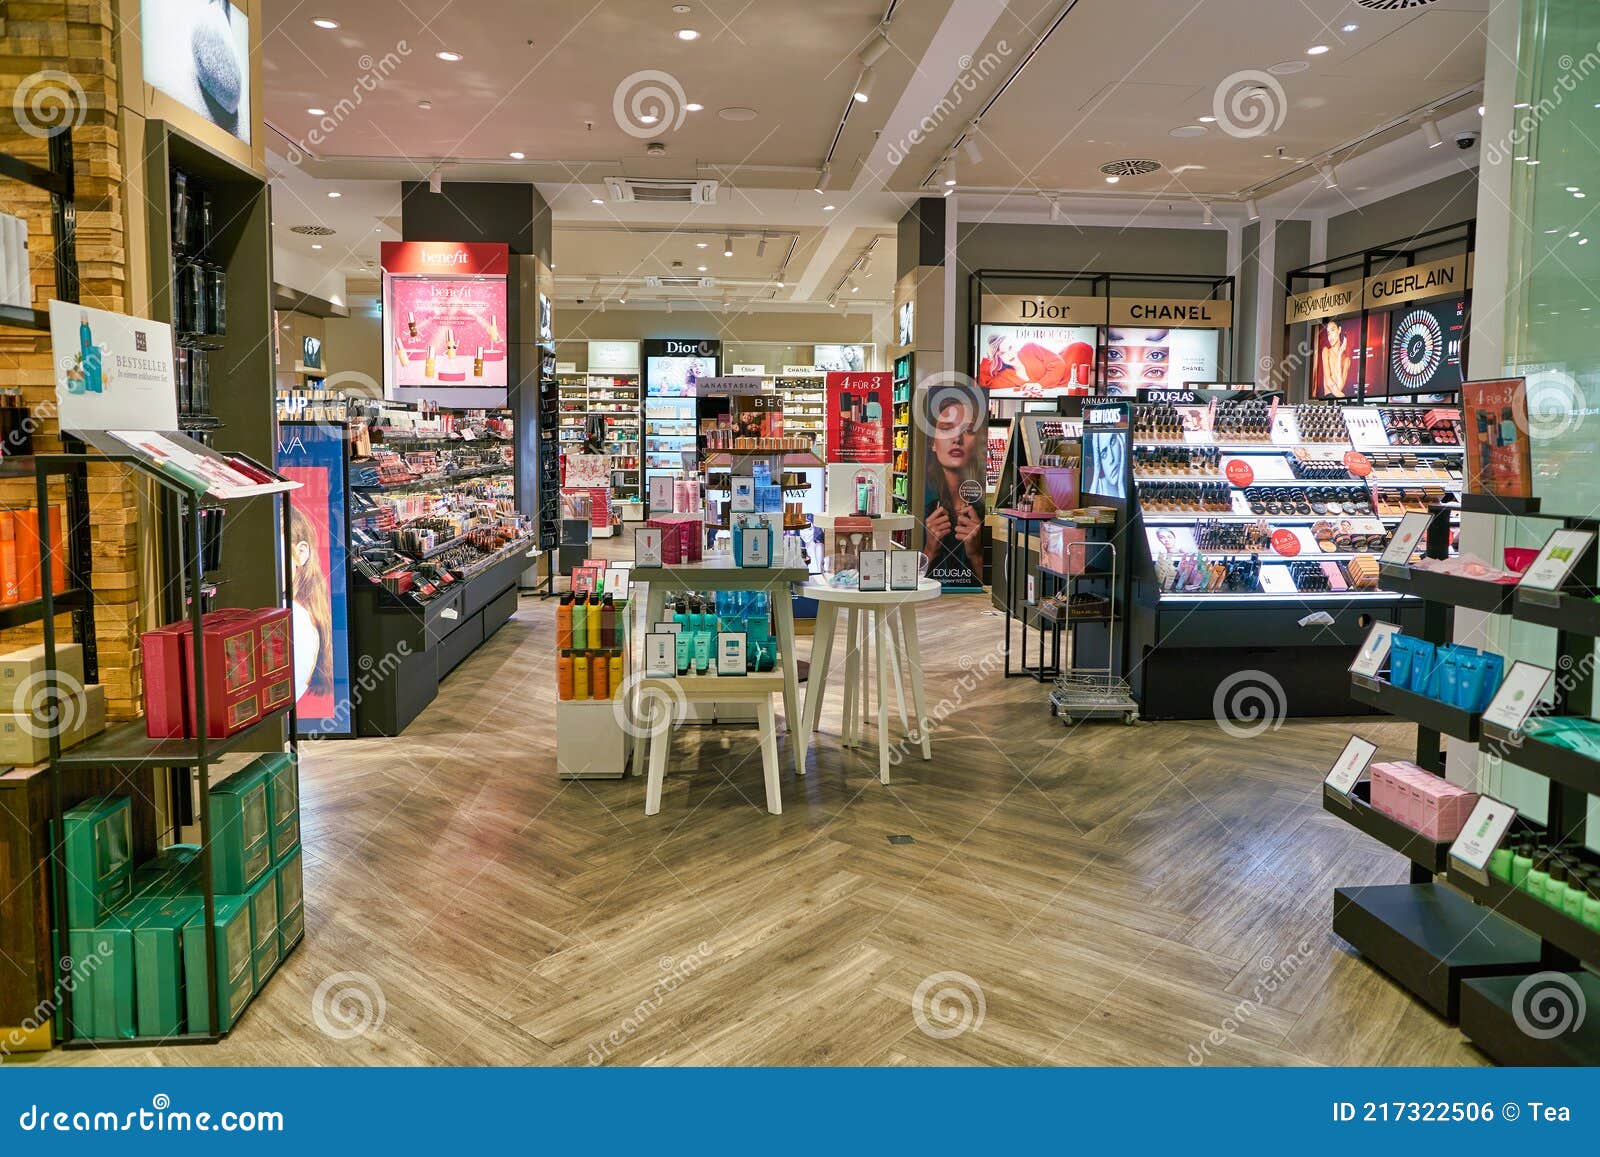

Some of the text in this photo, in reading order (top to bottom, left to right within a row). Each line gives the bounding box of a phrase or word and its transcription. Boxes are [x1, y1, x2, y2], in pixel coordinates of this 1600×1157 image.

[421, 251, 469, 266] benefit
[1372, 266, 1454, 299] GUERLAIN
[430, 285, 472, 298] benefit
[1020, 300, 1071, 319] Dior
[1130, 304, 1212, 321] CHANEL
[667, 341, 699, 354] Dior
[116, 355, 167, 373] BESTSELLER
[841, 376, 851, 390] 4
[853, 379, 869, 390] FÜR
[1148, 391, 1194, 402] DOUGLAS
[933, 568, 972, 578] DOUGLAS
